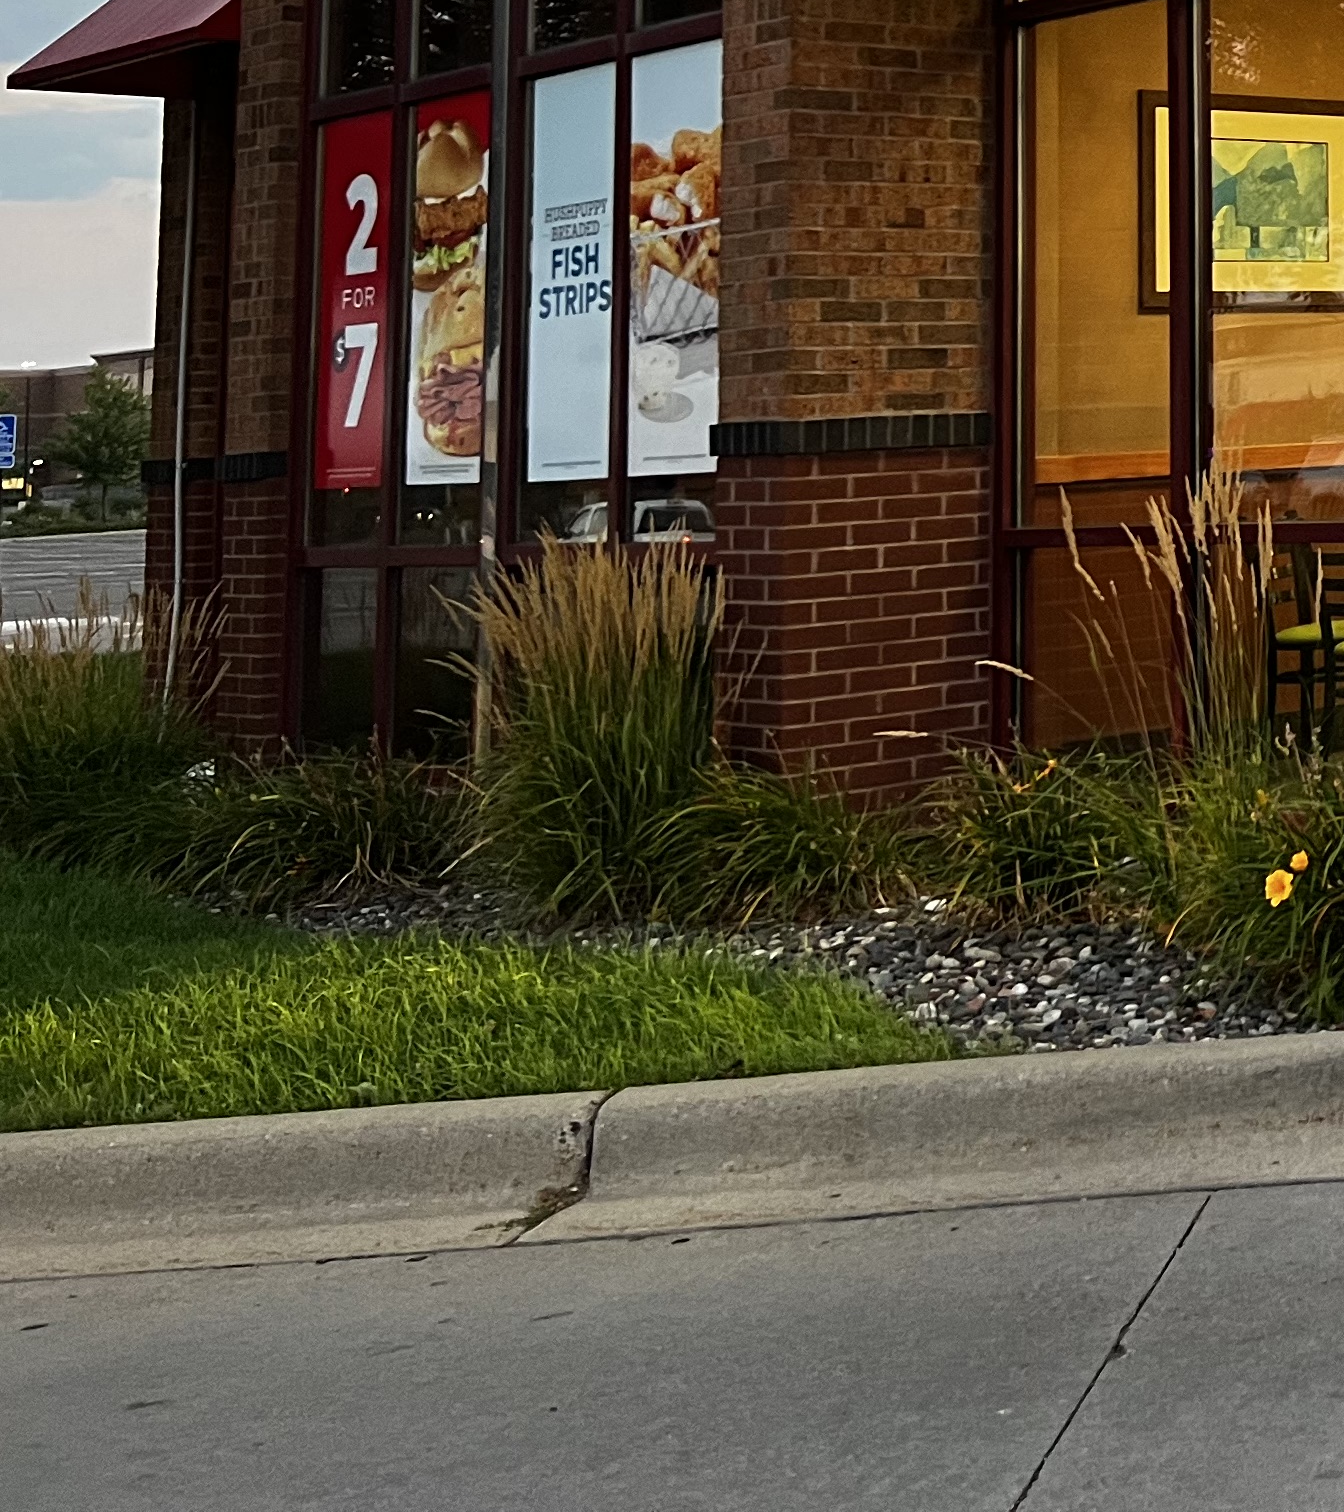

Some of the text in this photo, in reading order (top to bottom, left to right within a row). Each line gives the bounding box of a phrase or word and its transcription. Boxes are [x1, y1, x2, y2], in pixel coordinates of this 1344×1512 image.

[346, 173, 379, 276] 2
[545, 198, 608, 223] HUSHPUPPY
[551, 220, 600, 241] BREADED
[552, 243, 599, 280] FISH
[341, 286, 376, 310] FOR
[539, 279, 612, 319] STRIPS
